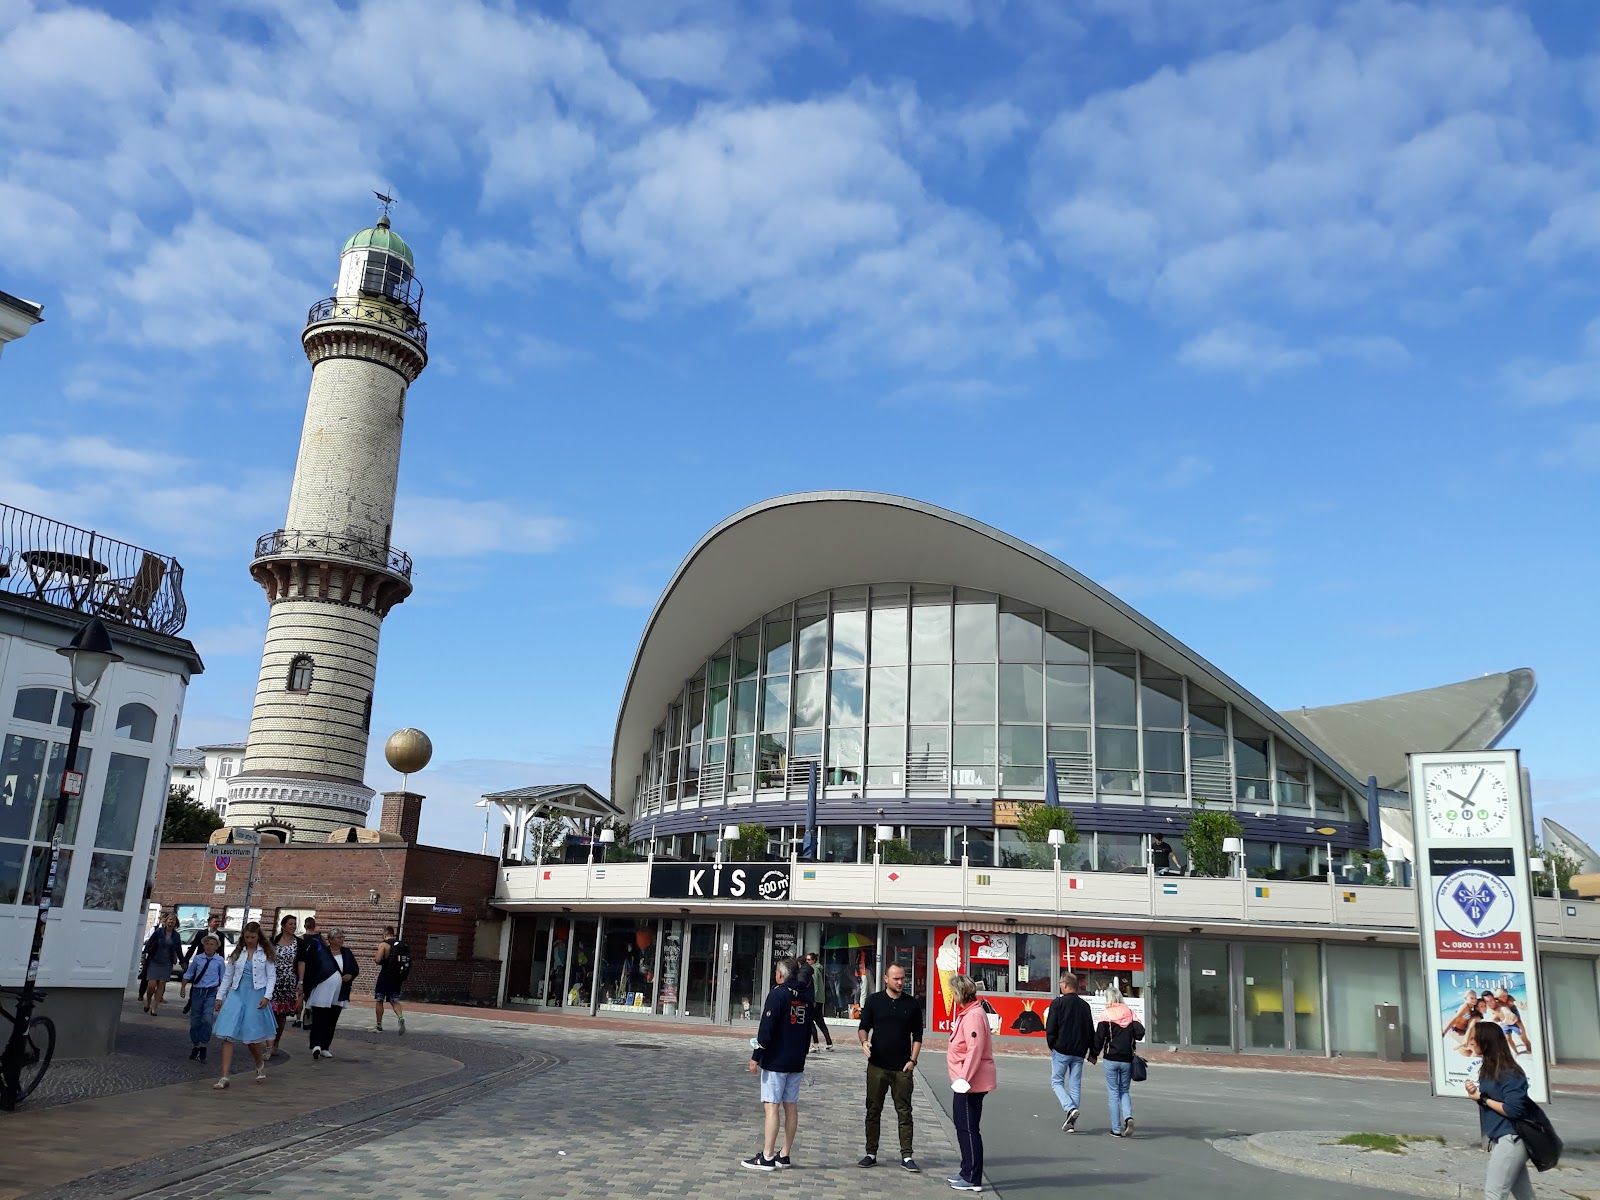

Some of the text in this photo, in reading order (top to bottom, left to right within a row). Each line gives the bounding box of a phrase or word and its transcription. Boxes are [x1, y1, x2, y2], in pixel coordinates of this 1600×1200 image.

[210, 847, 219, 855] Am
[759, 881, 777, 896] 500
[1458, 889, 1467, 903] S
[1471, 906, 1481, 919] B
[1069, 936, 1137, 949] Dänisches
[1080, 951, 1127, 965] Softeis
[1451, 974, 1514, 990] Urlaub
